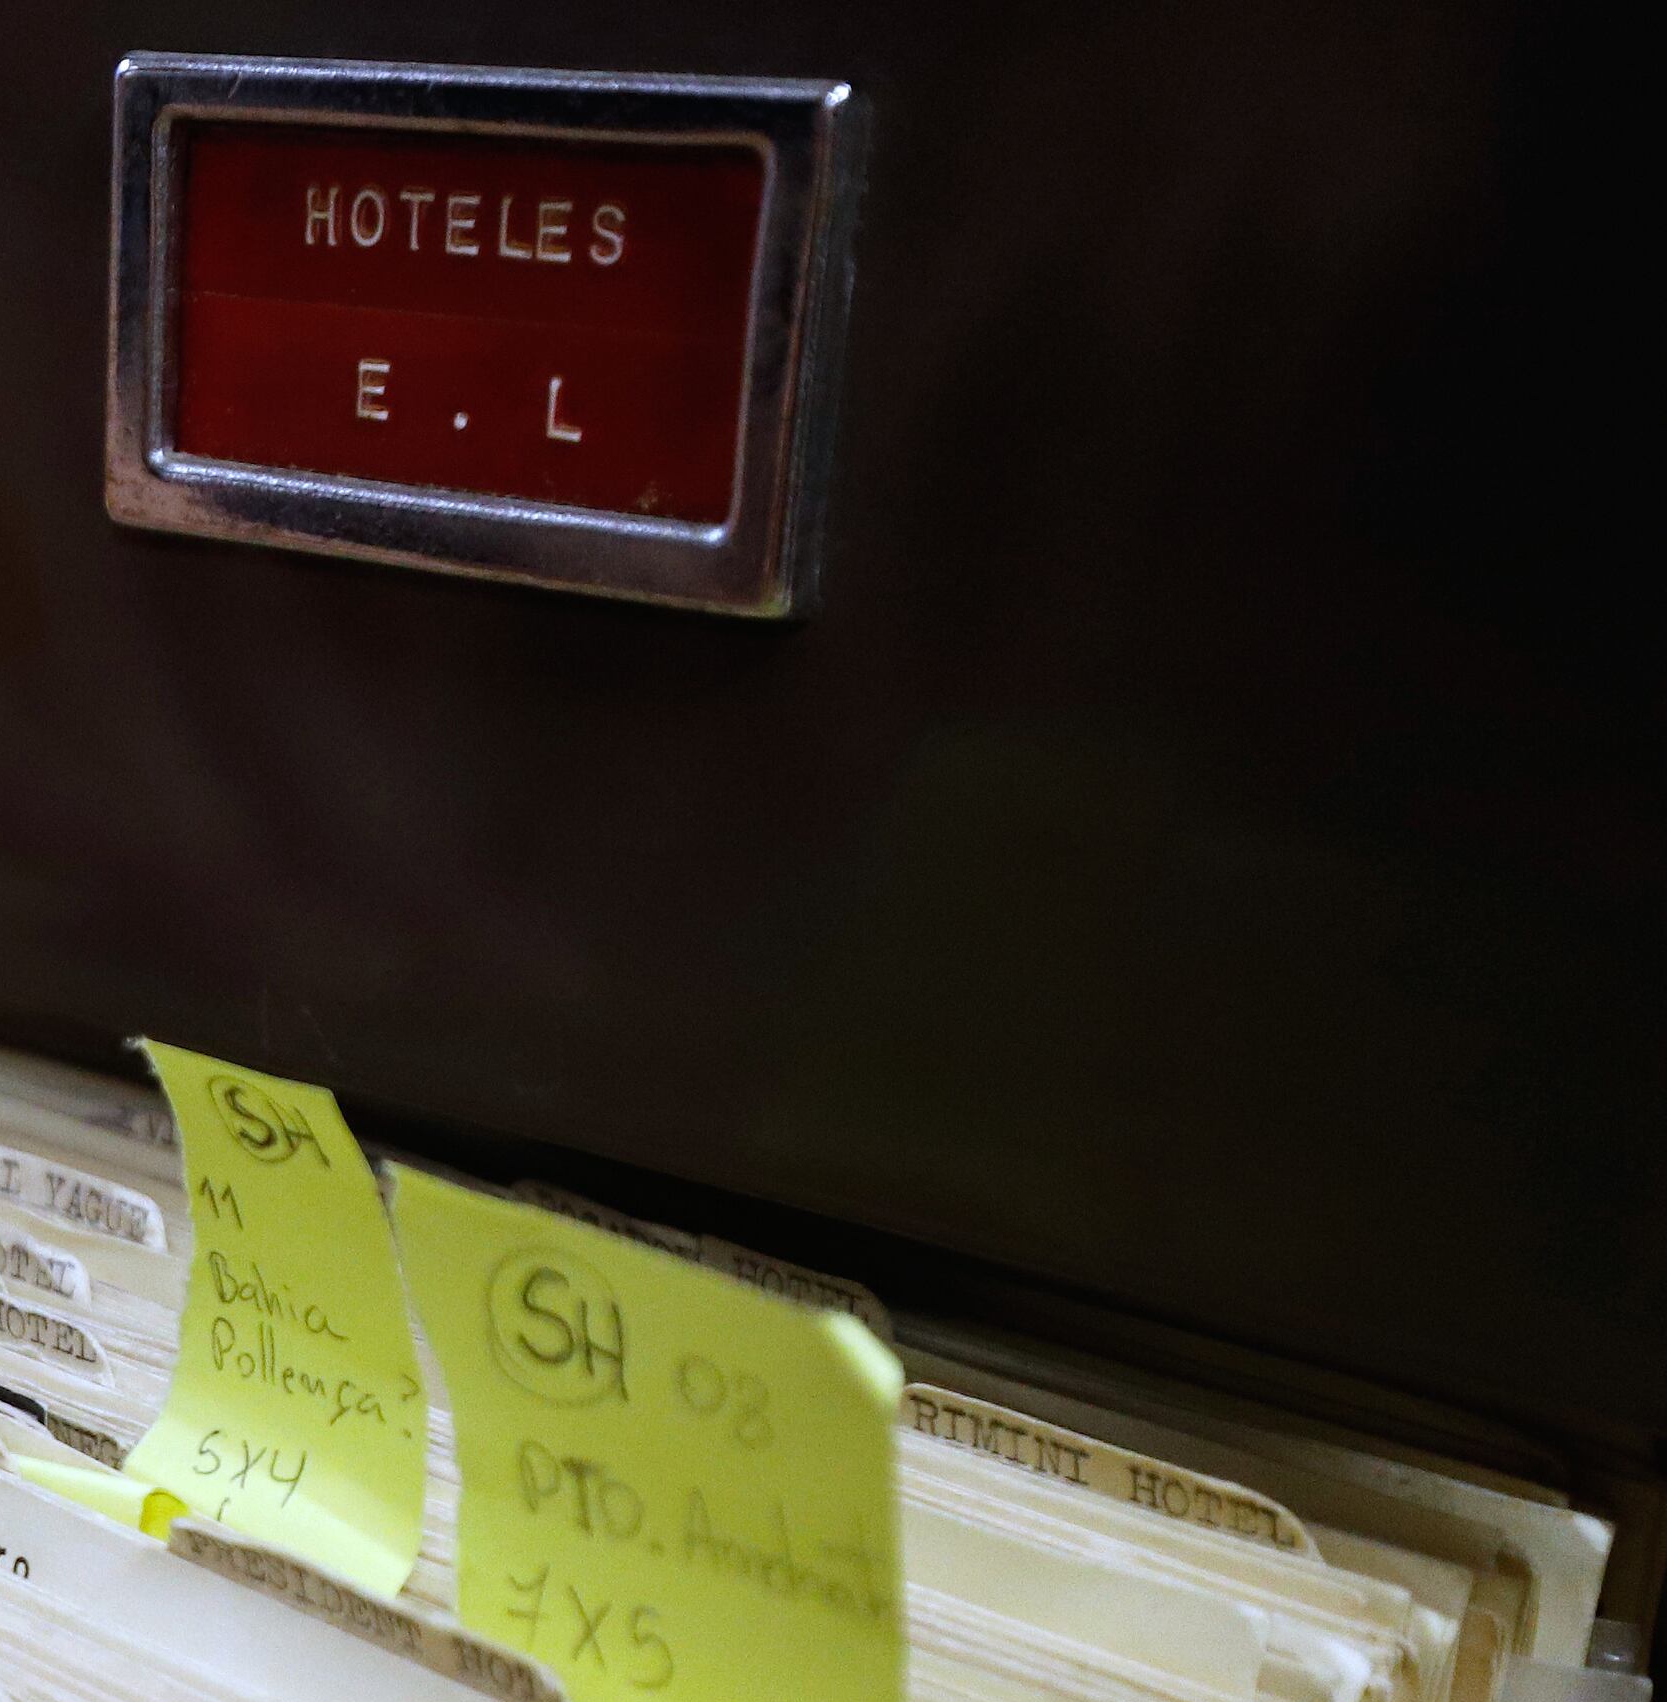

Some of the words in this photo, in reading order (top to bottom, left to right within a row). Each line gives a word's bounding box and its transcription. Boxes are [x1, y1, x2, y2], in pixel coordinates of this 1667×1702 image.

[304, 185, 627, 267] HOTELES
[356, 358, 392, 422] E
[545, 376, 583, 442] L
[46, 1169, 150, 1244] YAGUE
[198, 1175, 244, 1233] 11
[517, 1265, 630, 1402] SH
[1126, 1460, 1297, 1551] HOTEL
